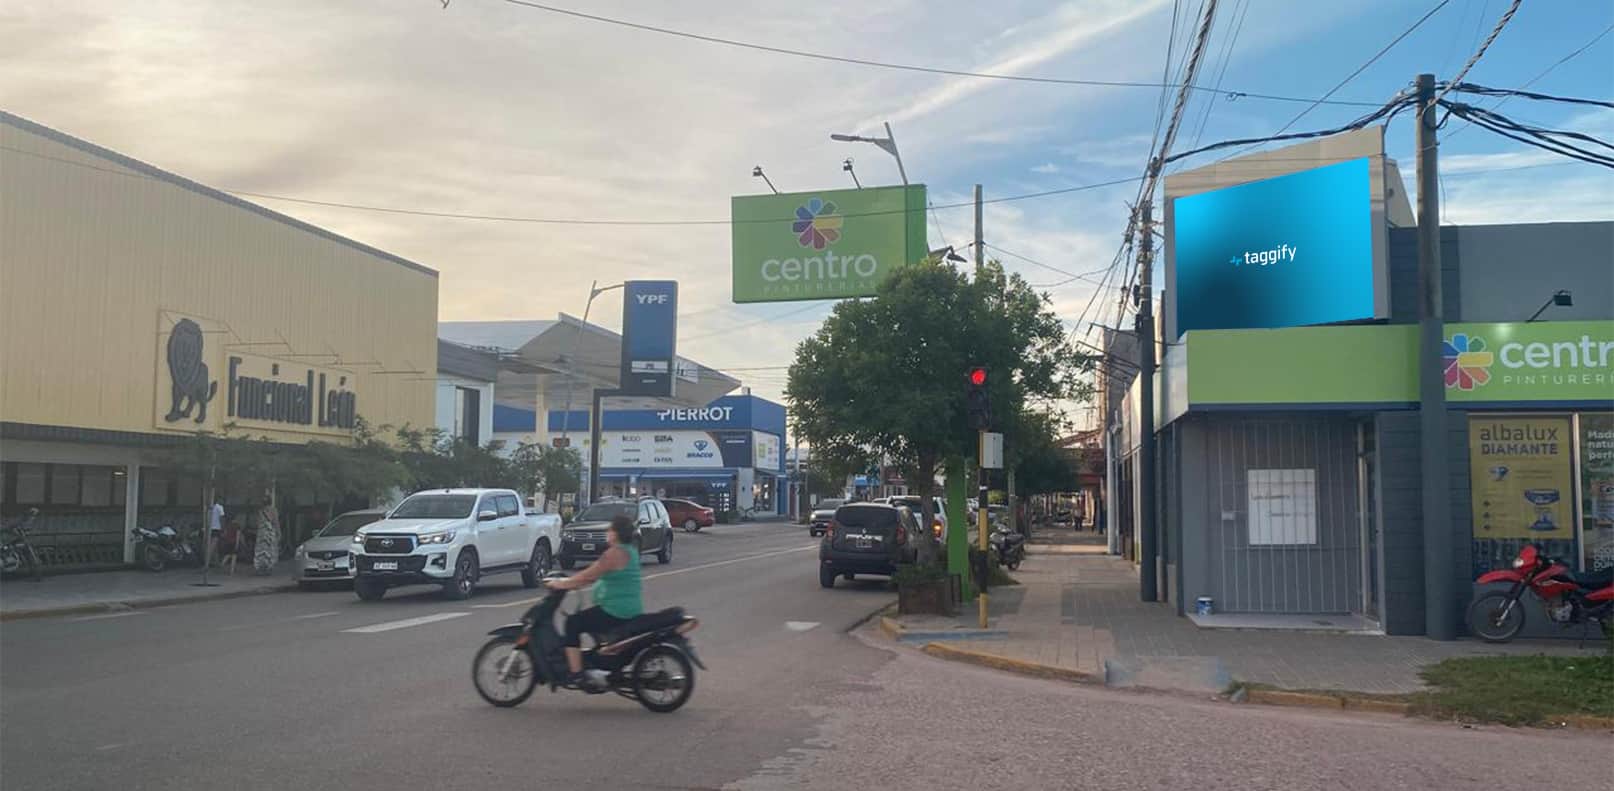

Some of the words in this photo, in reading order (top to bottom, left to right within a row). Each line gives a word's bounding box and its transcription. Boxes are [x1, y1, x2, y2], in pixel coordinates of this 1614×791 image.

[1244, 244, 1297, 266] taggify
[761, 251, 877, 282] centro
[636, 294, 669, 305] YPF
[227, 355, 314, 425] Funcional
[318, 372, 356, 430] León
[656, 406, 734, 421] PIERROT
[1480, 424, 1559, 441] albalux
[1588, 430, 1614, 439] Mad
[1481, 443, 1559, 455] DIAMANTE
